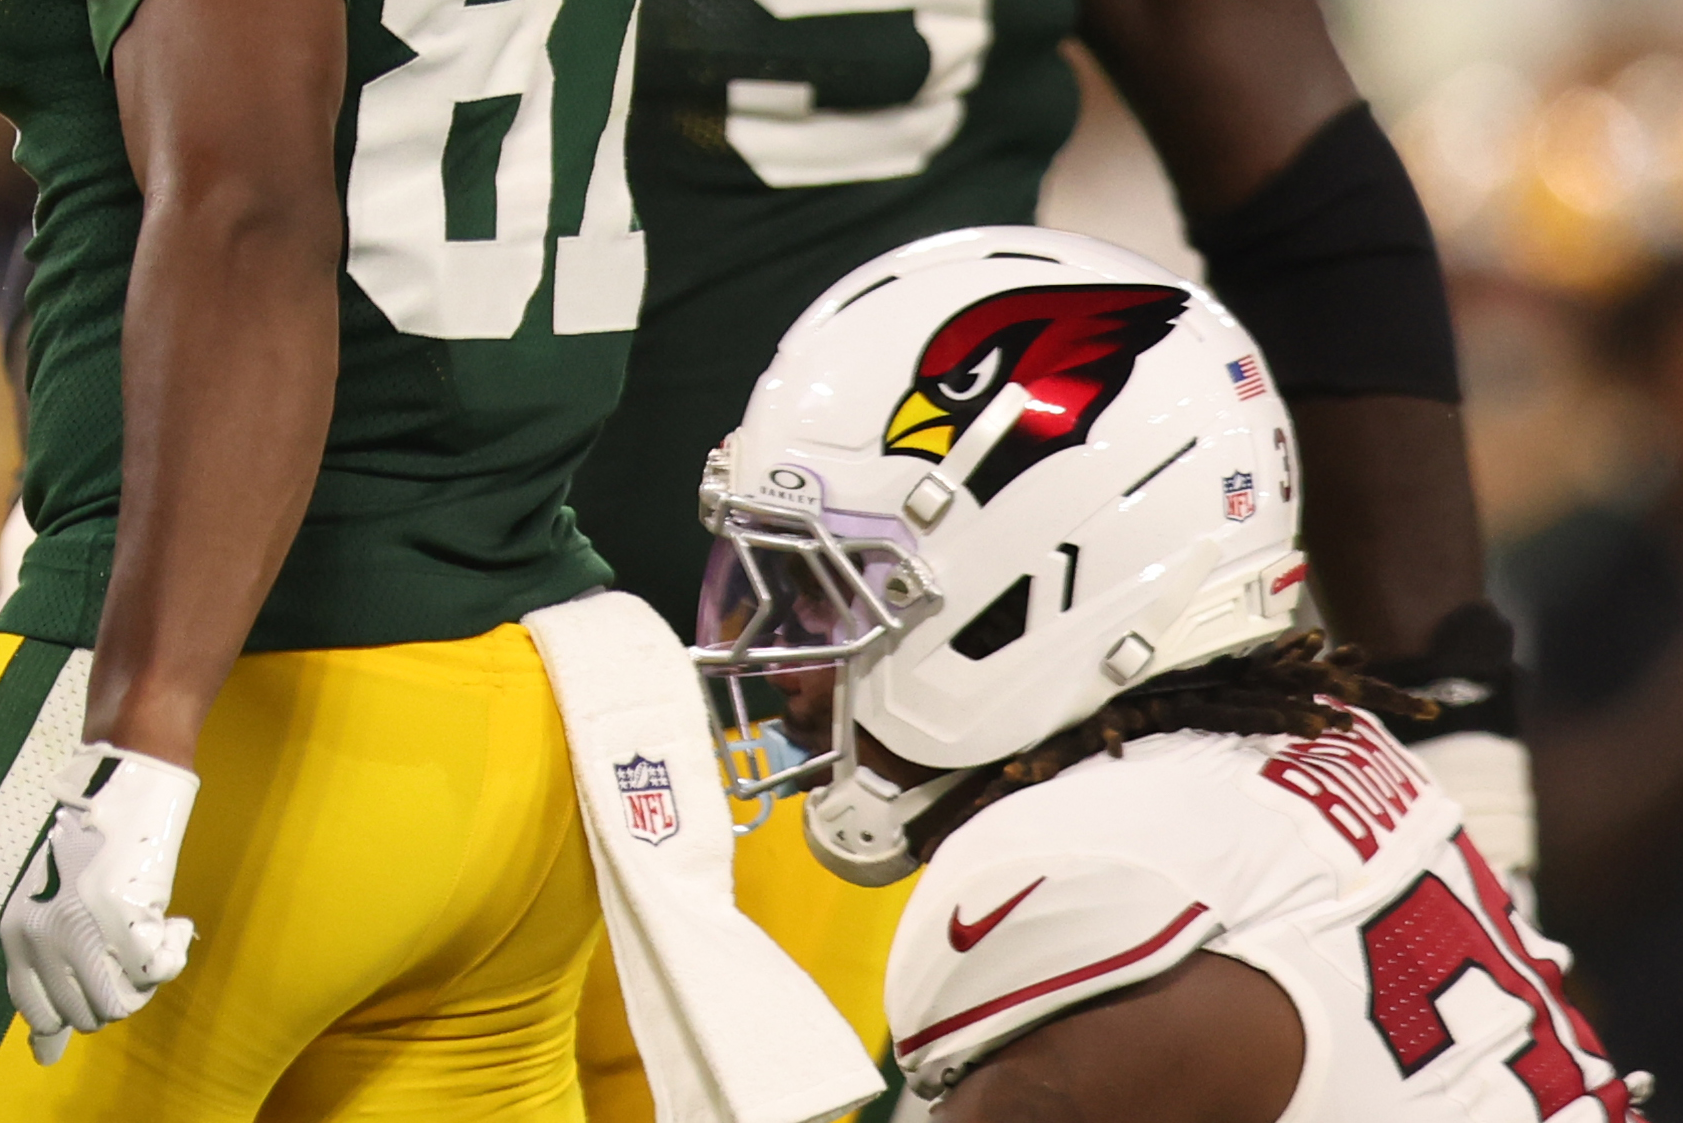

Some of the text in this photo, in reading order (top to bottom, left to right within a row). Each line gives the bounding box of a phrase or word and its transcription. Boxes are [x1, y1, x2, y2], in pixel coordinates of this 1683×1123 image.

[759, 485, 817, 505] OAKLEY
[1226, 492, 1256, 518] NFL
[627, 792, 674, 835] NFL
